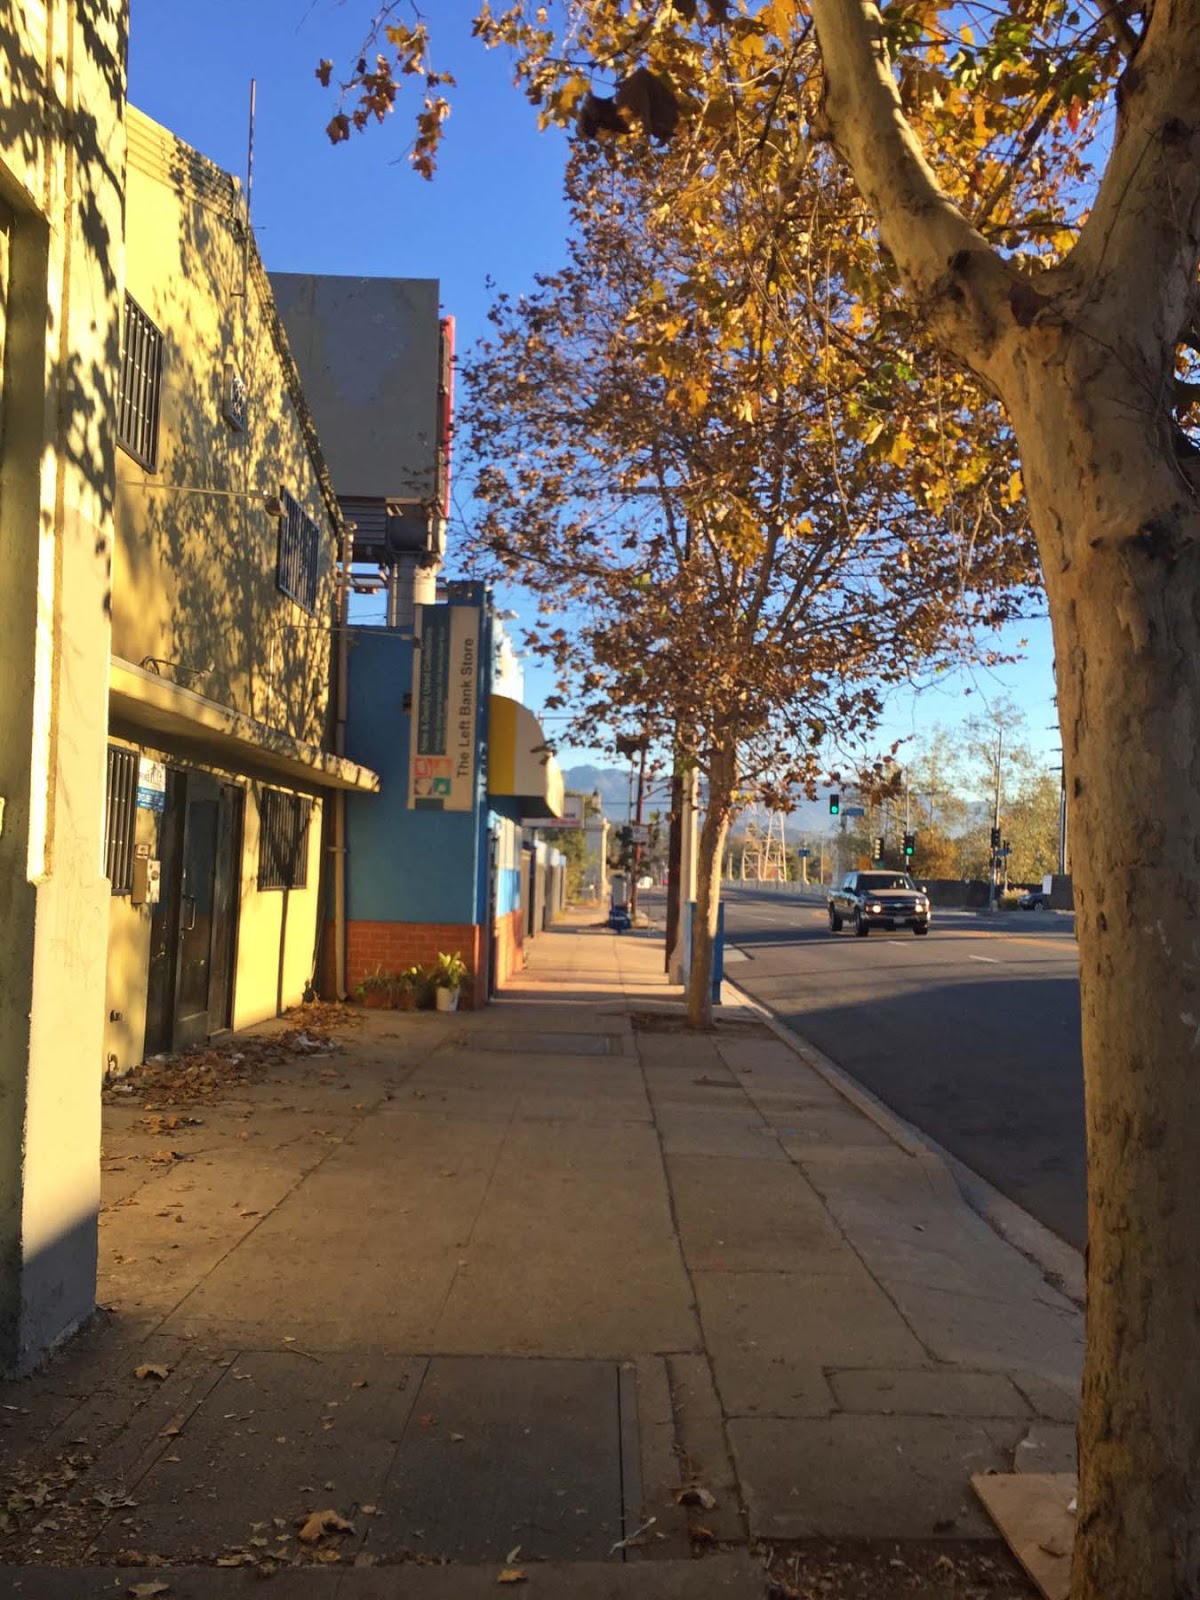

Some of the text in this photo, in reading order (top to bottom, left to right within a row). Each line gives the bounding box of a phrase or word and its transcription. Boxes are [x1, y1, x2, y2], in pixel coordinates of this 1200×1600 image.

[457, 638, 475, 777] The Left Bank Store
